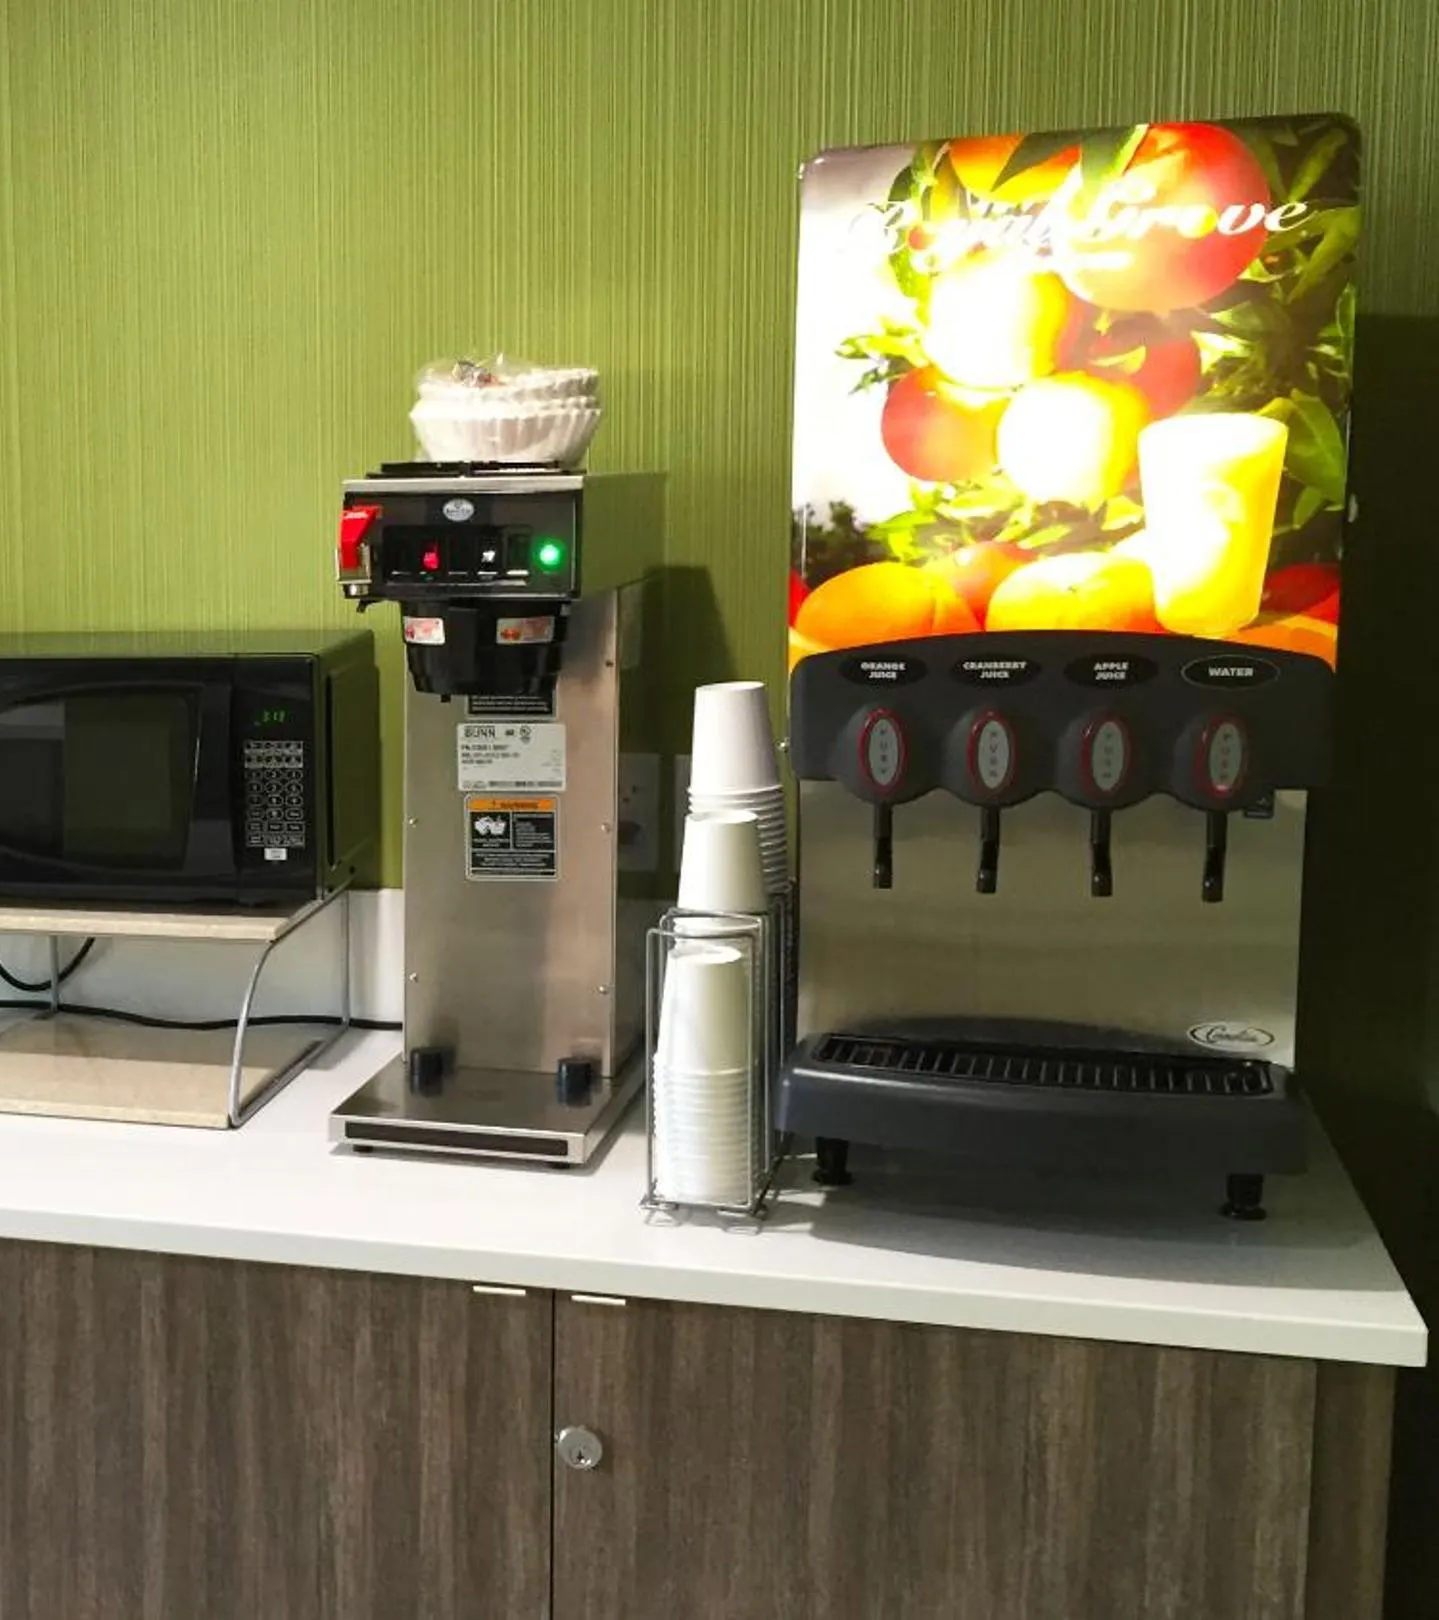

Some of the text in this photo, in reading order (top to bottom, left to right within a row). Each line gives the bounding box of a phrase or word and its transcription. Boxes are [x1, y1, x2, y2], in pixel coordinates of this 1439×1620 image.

[860, 661, 907, 671] ORANGE
[962, 660, 1028, 671] CRANBERRY
[1093, 661, 1130, 672] APPLE
[868, 670, 898, 680] JUICE
[979, 670, 1010, 679] JUICE
[1094, 671, 1127, 681] JUICE
[1208, 666, 1254, 678] WATER
